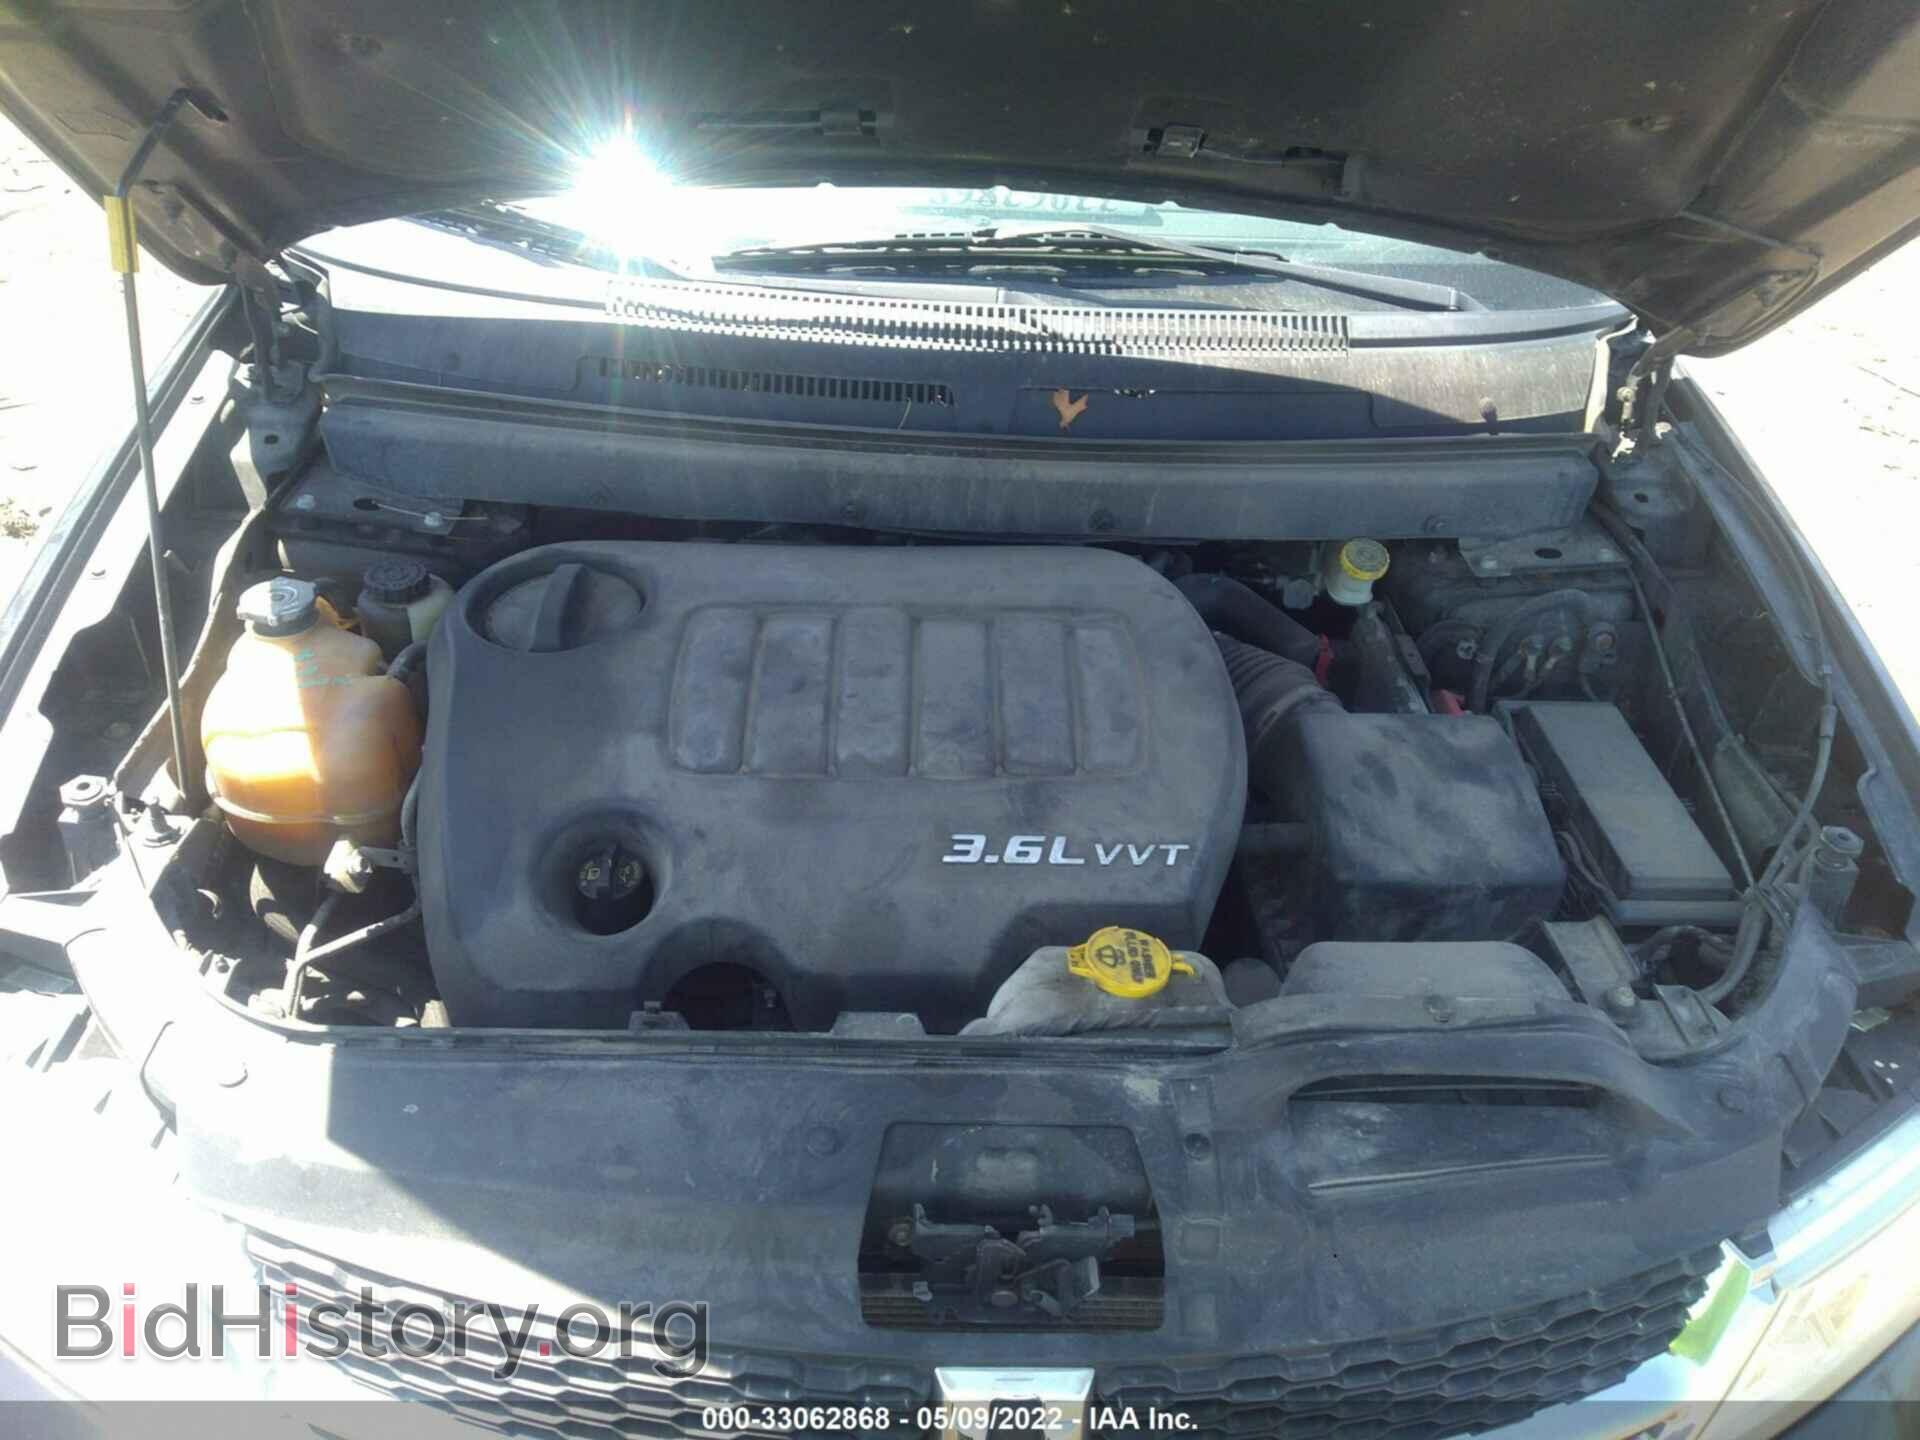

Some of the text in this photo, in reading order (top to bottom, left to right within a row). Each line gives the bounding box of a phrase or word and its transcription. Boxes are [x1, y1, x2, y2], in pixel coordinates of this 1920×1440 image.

[942, 834, 1190, 866] 3.6L VVT
[1124, 931, 1139, 958] FLUID
[1139, 939, 1157, 979] WASHER
